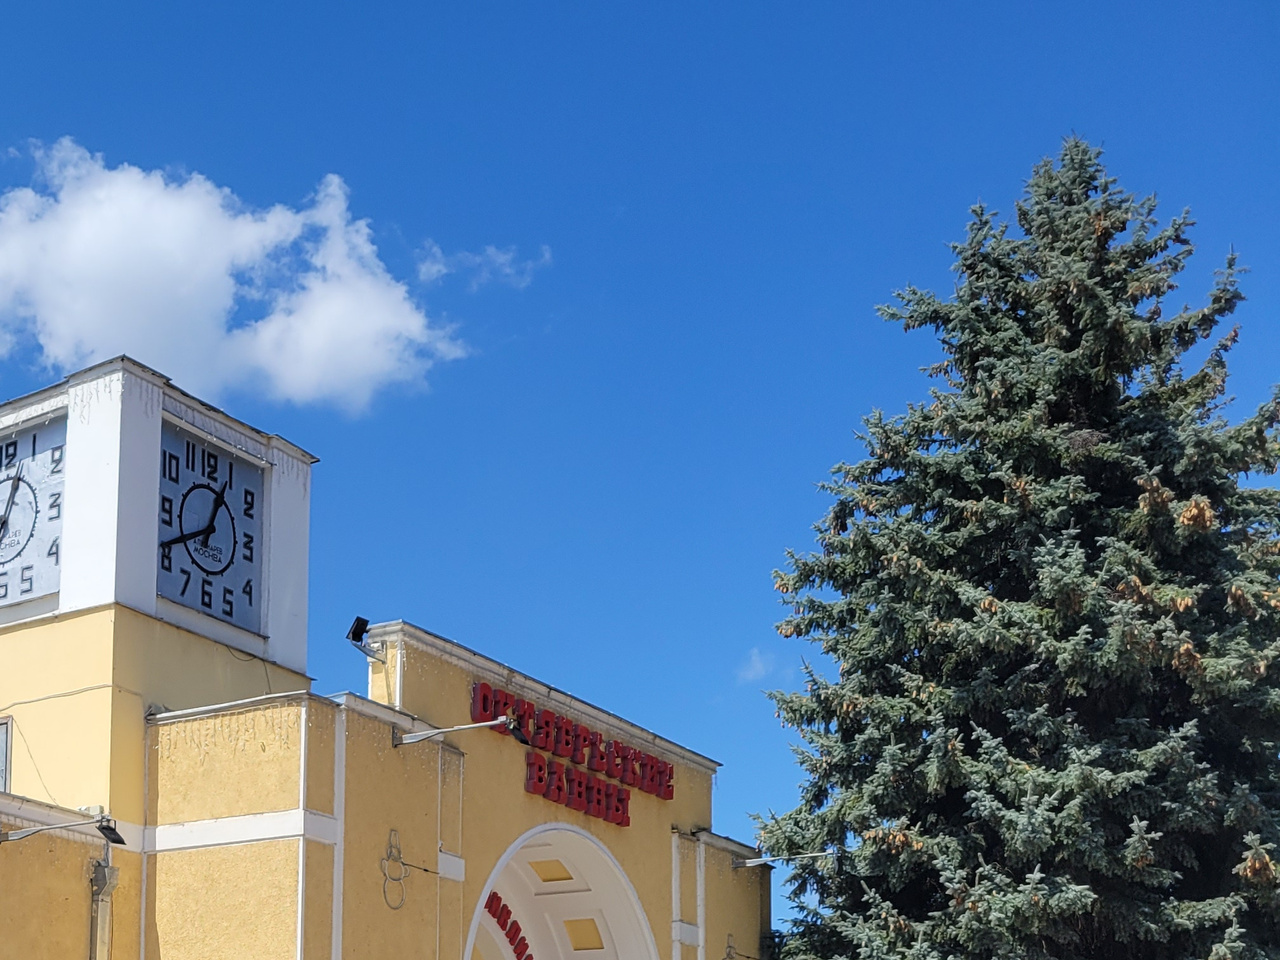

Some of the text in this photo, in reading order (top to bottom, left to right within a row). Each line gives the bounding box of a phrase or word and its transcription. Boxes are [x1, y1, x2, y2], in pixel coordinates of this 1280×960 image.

[0, 440, 18, 472] 12
[31, 433, 37, 462] 1
[51, 446, 64, 474] 2
[186, 440, 196, 472] 11
[162, 450, 180, 485] 10
[201, 448, 218, 483] 12
[228, 461, 233, 490] 1
[49, 493, 61, 521] 3
[161, 494, 173, 527] 9
[243, 488, 254, 519] 2
[47, 538, 59, 566] 4
[160, 542, 172, 573] 8
[243, 532, 254, 563] 3
[21, 565, 33, 595] 5
[180, 568, 191, 598] 7
[201, 577, 212, 609] 6
[242, 578, 253, 607] 4
[222, 586, 234, 618] 5
[471, 682, 674, 800] ОКТЯБРЬСКИЕ
[524, 752, 631, 827] ВАННЫ
